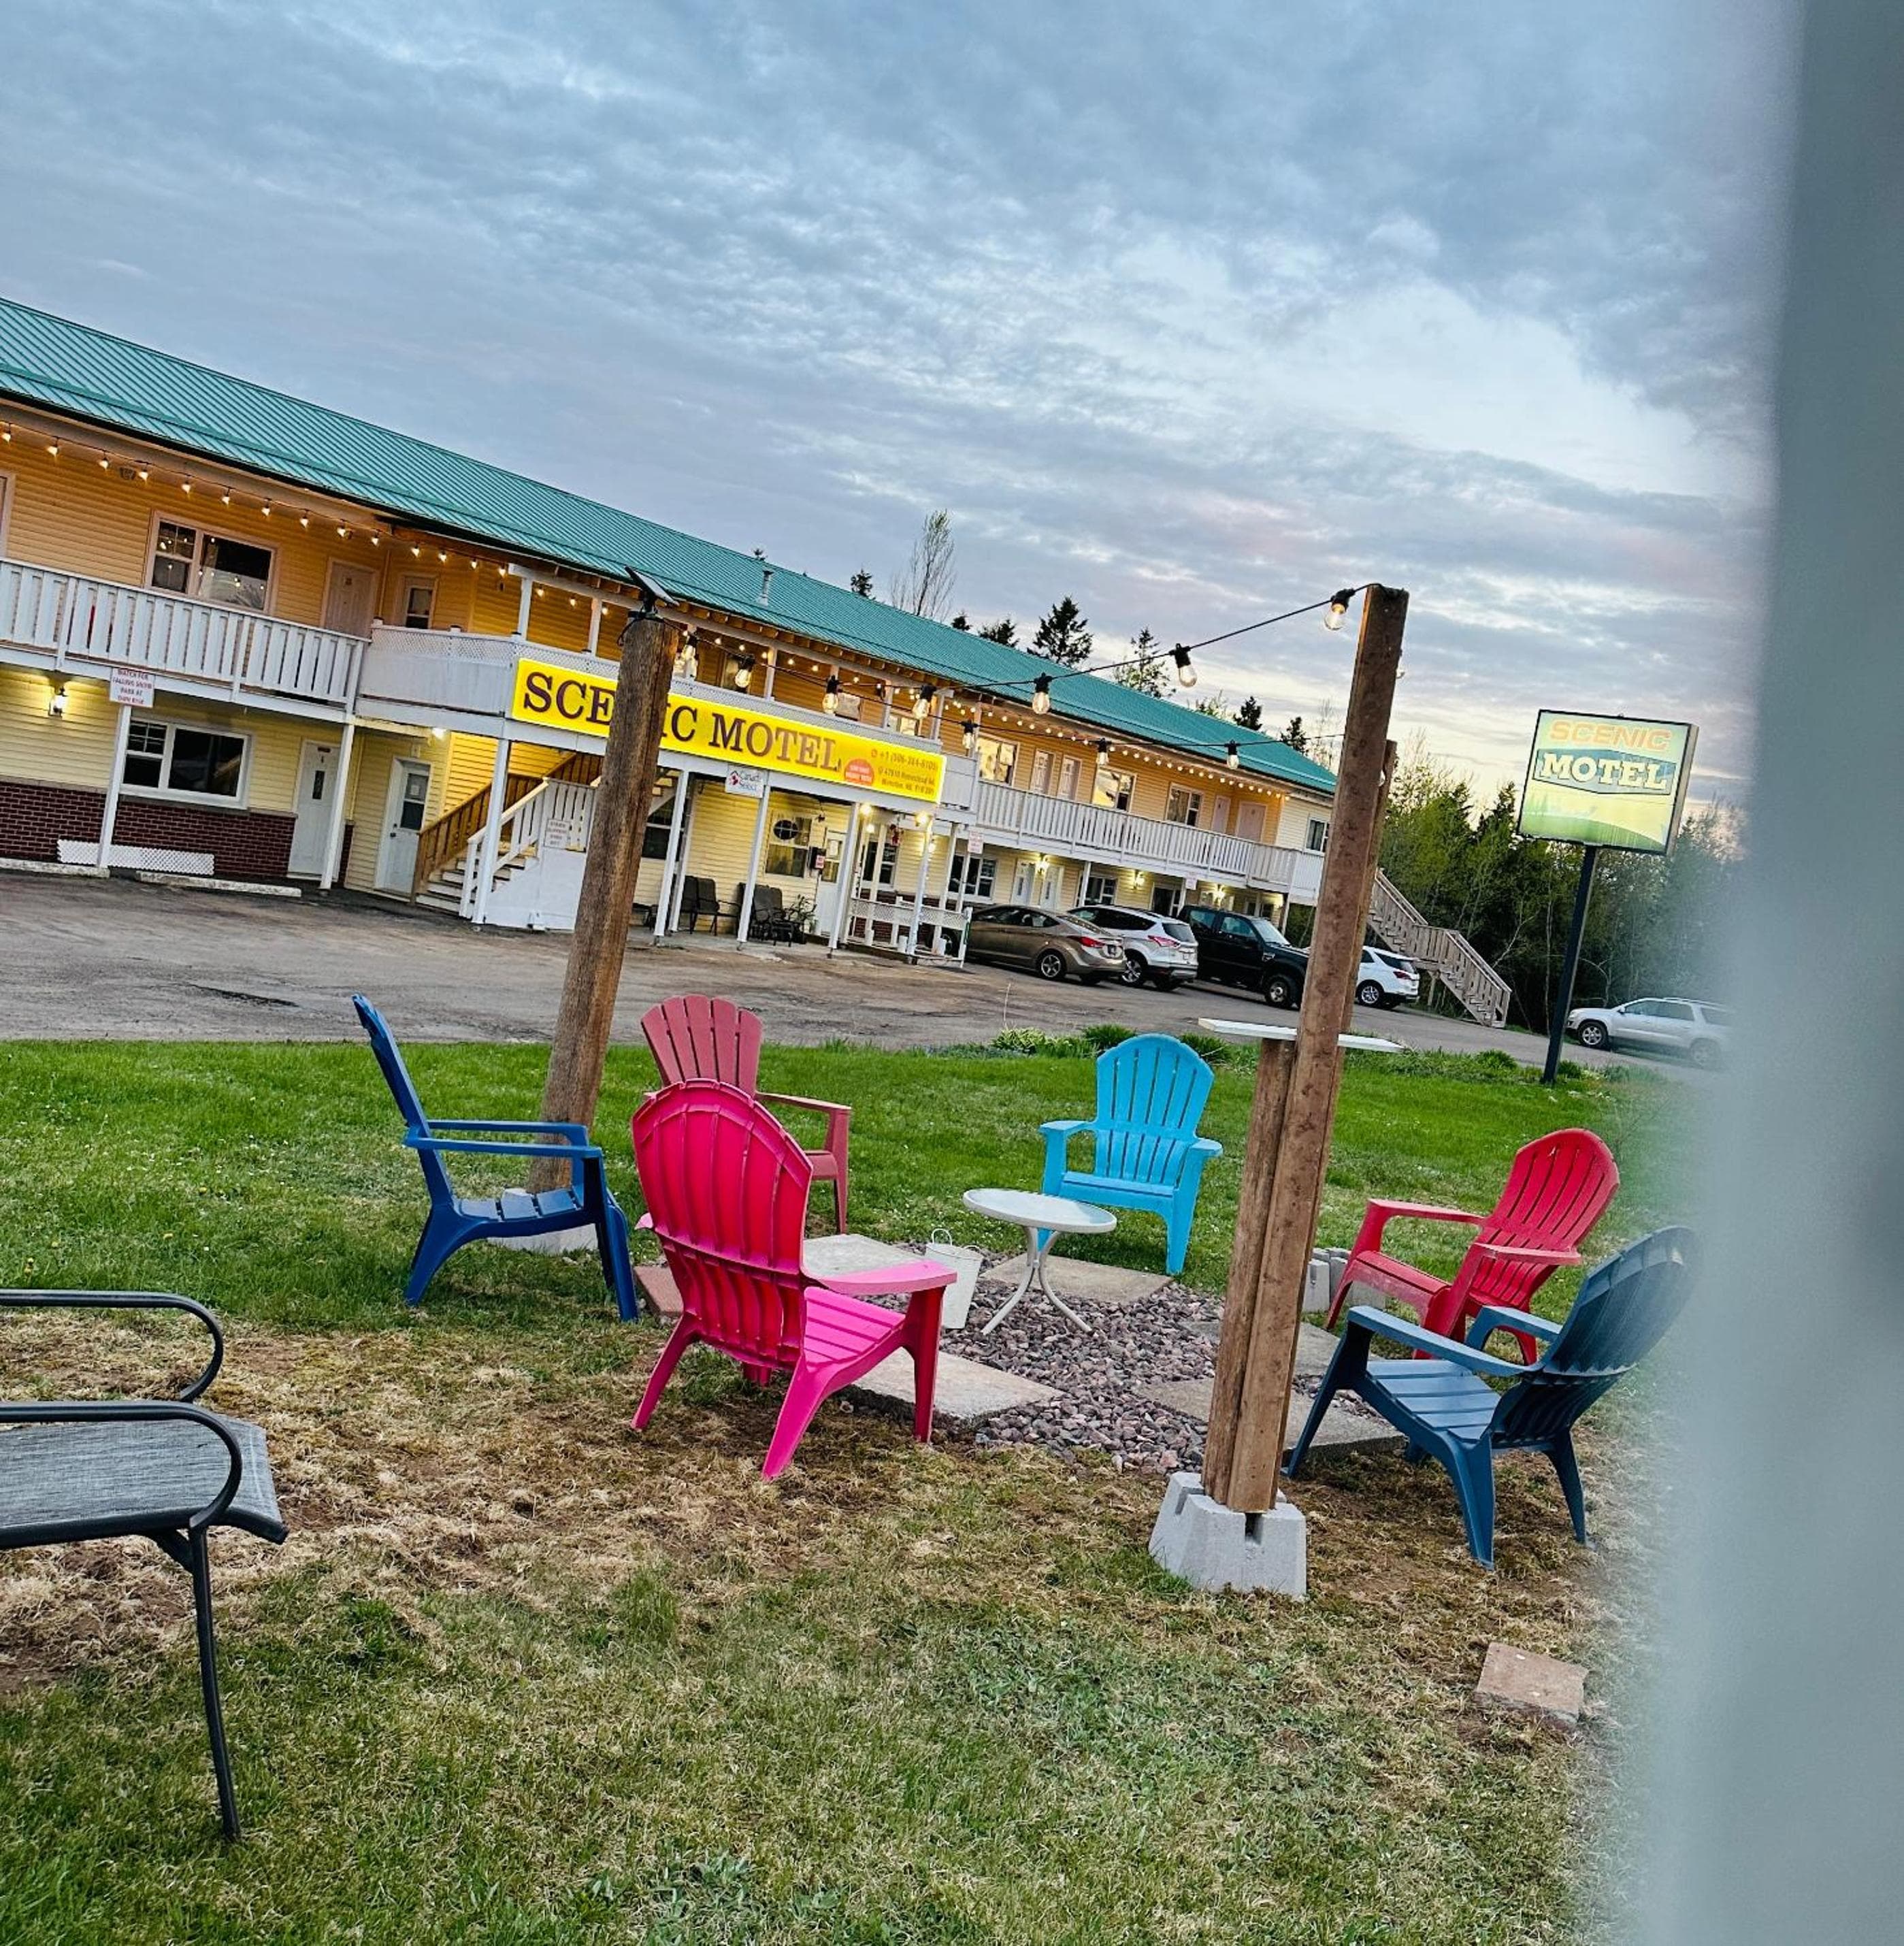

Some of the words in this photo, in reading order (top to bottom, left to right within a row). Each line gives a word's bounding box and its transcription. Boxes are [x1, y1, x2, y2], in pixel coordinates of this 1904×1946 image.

[523, 671, 697, 742] SCEC
[708, 713, 842, 771] MOTEL
[1549, 719, 1672, 750] SCENIC
[1539, 753, 1668, 790] MOTEL
